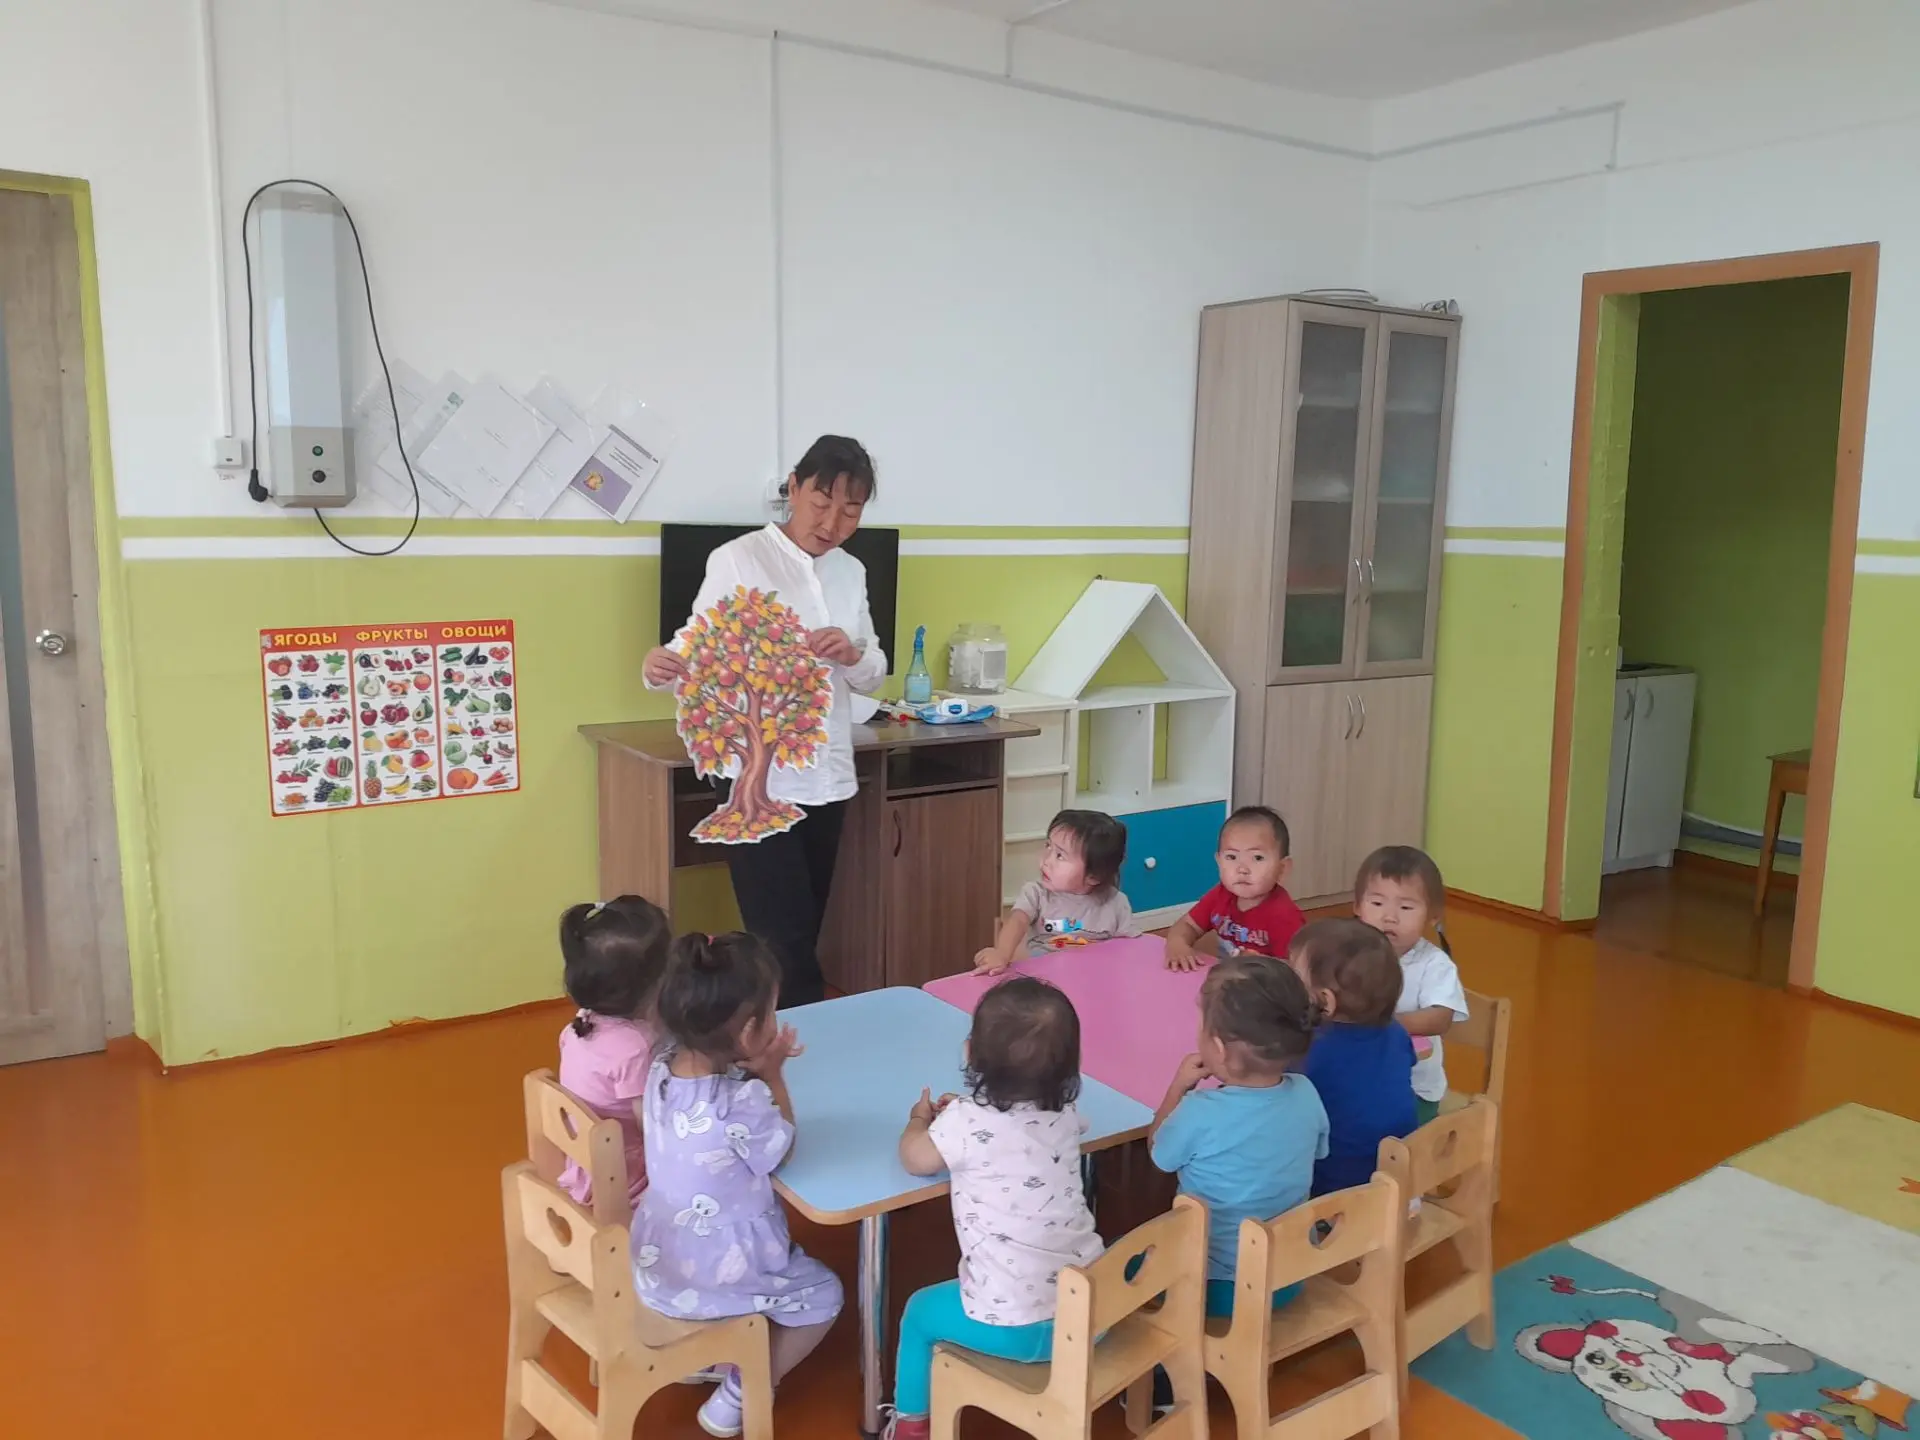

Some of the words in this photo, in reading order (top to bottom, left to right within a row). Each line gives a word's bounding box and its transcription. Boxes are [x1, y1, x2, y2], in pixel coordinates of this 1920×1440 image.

[274, 631, 337, 646] ЯГОДЫ
[356, 627, 428, 642] ФРУКТЫ
[441, 624, 506, 639] ОВОЩИ
